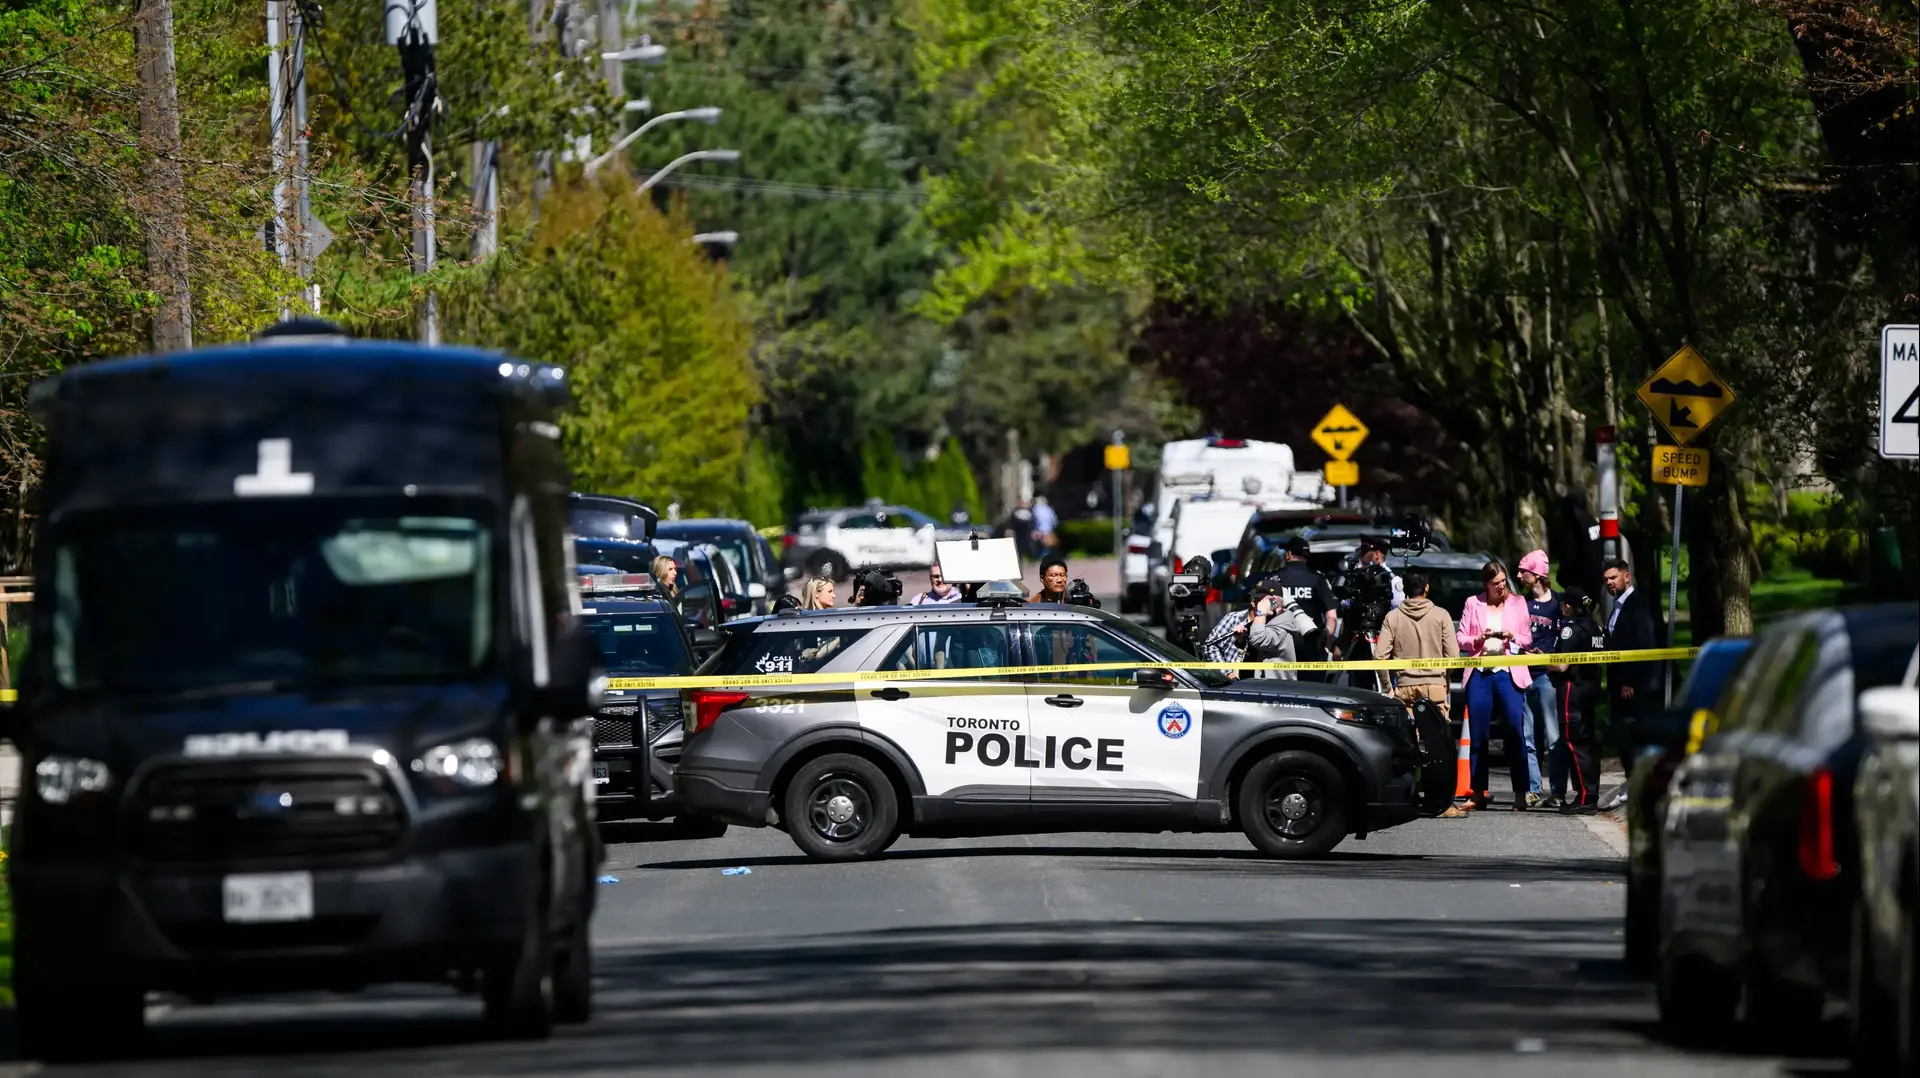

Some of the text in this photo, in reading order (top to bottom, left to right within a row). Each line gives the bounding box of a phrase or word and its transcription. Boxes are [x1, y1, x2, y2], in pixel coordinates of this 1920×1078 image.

[1662, 452, 1701, 465] SPEED
[1663, 467, 1698, 479] BUMP
[1283, 586, 1312, 599] LICE
[765, 661, 792, 672] 9-1-1
[755, 698, 805, 714] 3321
[1272, 701, 1311, 709] Protect
[947, 717, 1020, 731] TORONTO
[945, 731, 1124, 772] POLICE
